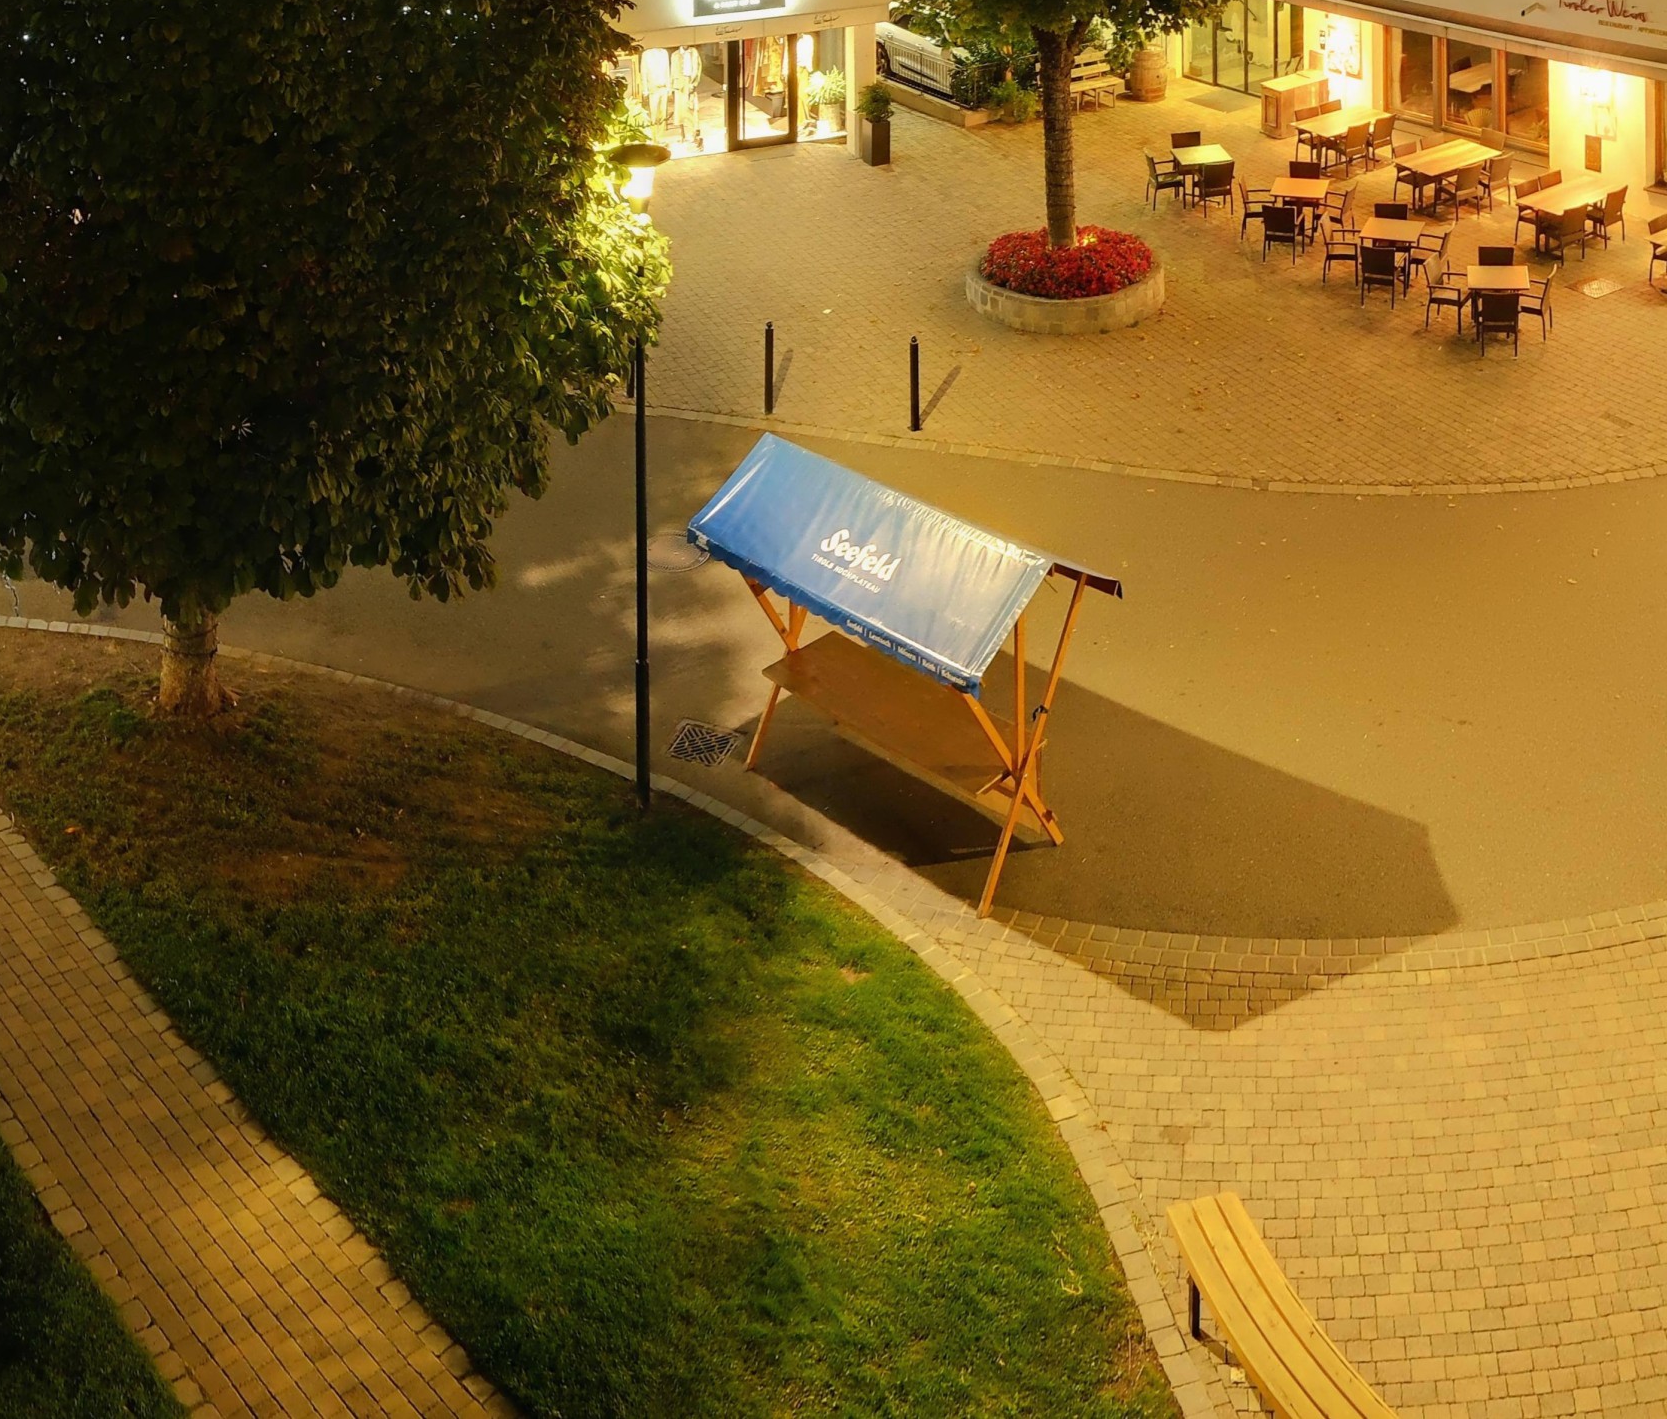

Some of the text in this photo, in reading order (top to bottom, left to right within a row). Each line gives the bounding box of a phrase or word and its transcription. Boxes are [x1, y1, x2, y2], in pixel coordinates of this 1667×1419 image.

[811, 552, 881, 594] TIROLS HOCHPLATEAU
[820, 528, 902, 582] Seefeld
